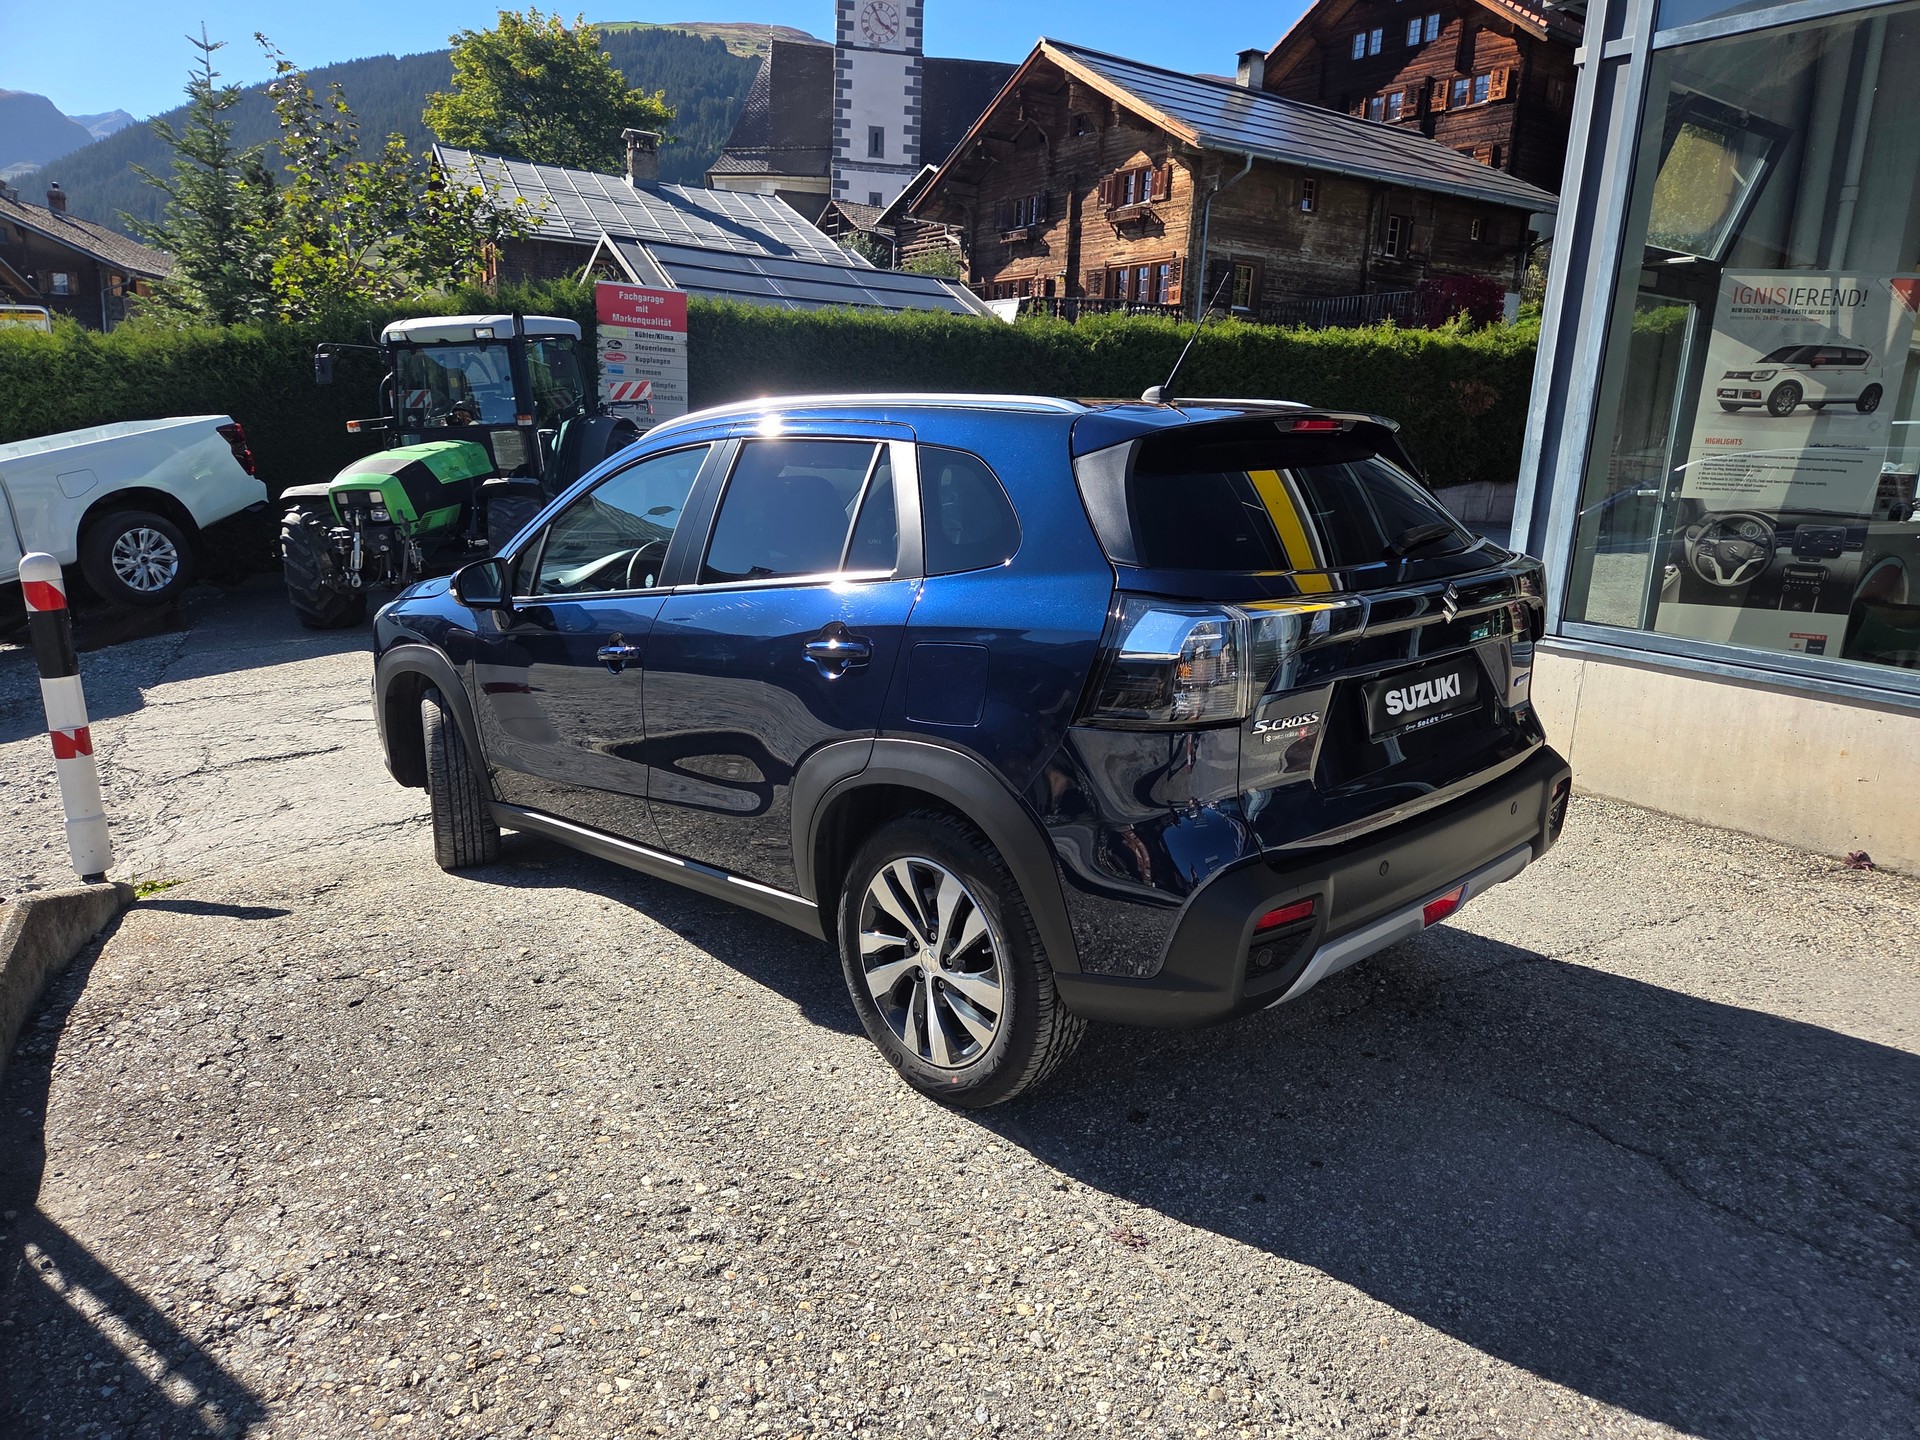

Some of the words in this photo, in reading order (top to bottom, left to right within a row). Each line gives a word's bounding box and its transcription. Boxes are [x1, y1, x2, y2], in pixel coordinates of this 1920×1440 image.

[618, 291, 665, 304] Fachgarage
[1733, 286, 1869, 307] IGNISIEREND!
[635, 305, 649, 314] mit
[612, 313, 672, 327] Markenqualität
[634, 331, 674, 341] Kühler/Klima
[634, 343, 676, 353] Steuerriemen
[635, 355, 671, 366] Kupplungen
[635, 368, 662, 376] Bremsen
[651, 381, 677, 389] dämpfer
[653, 393, 684, 401] bstechnik
[1704, 437, 1743, 446] HIGHLIGHTS
[1385, 672, 1461, 716] SUZUKI
[1251, 711, 1320, 735] S-CROSS
